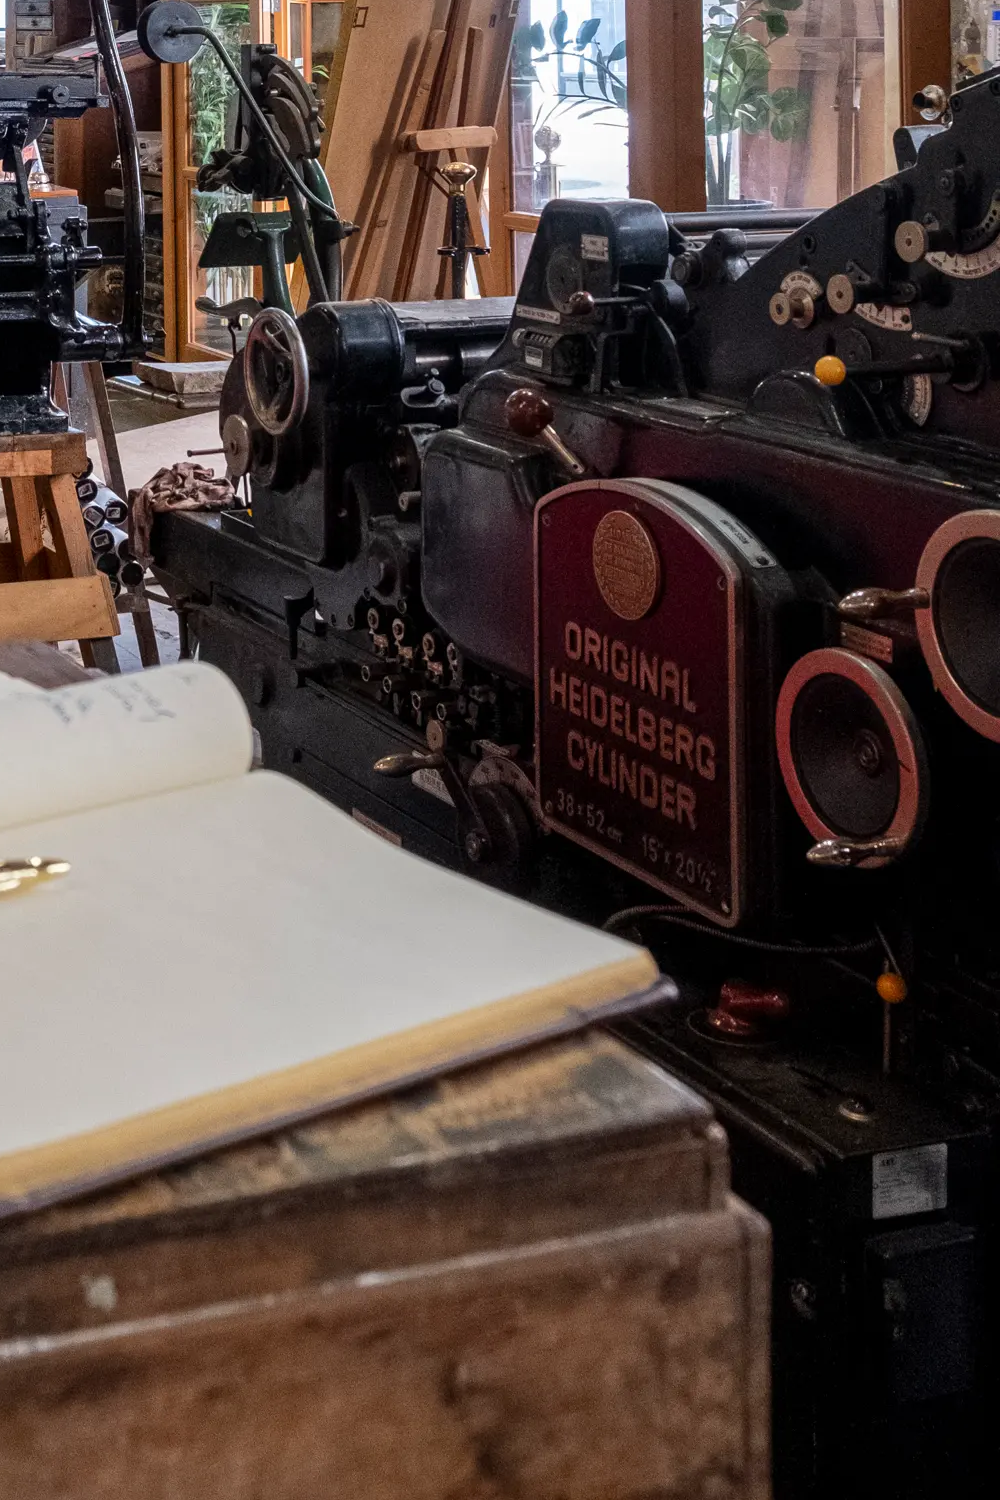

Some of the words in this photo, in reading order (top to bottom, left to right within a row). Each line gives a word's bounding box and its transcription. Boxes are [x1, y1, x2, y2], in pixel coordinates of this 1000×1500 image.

[565, 621, 697, 713] ORIGINAL
[549, 666, 718, 782] HEIDELBERG
[567, 731, 697, 831] CYLINDER
